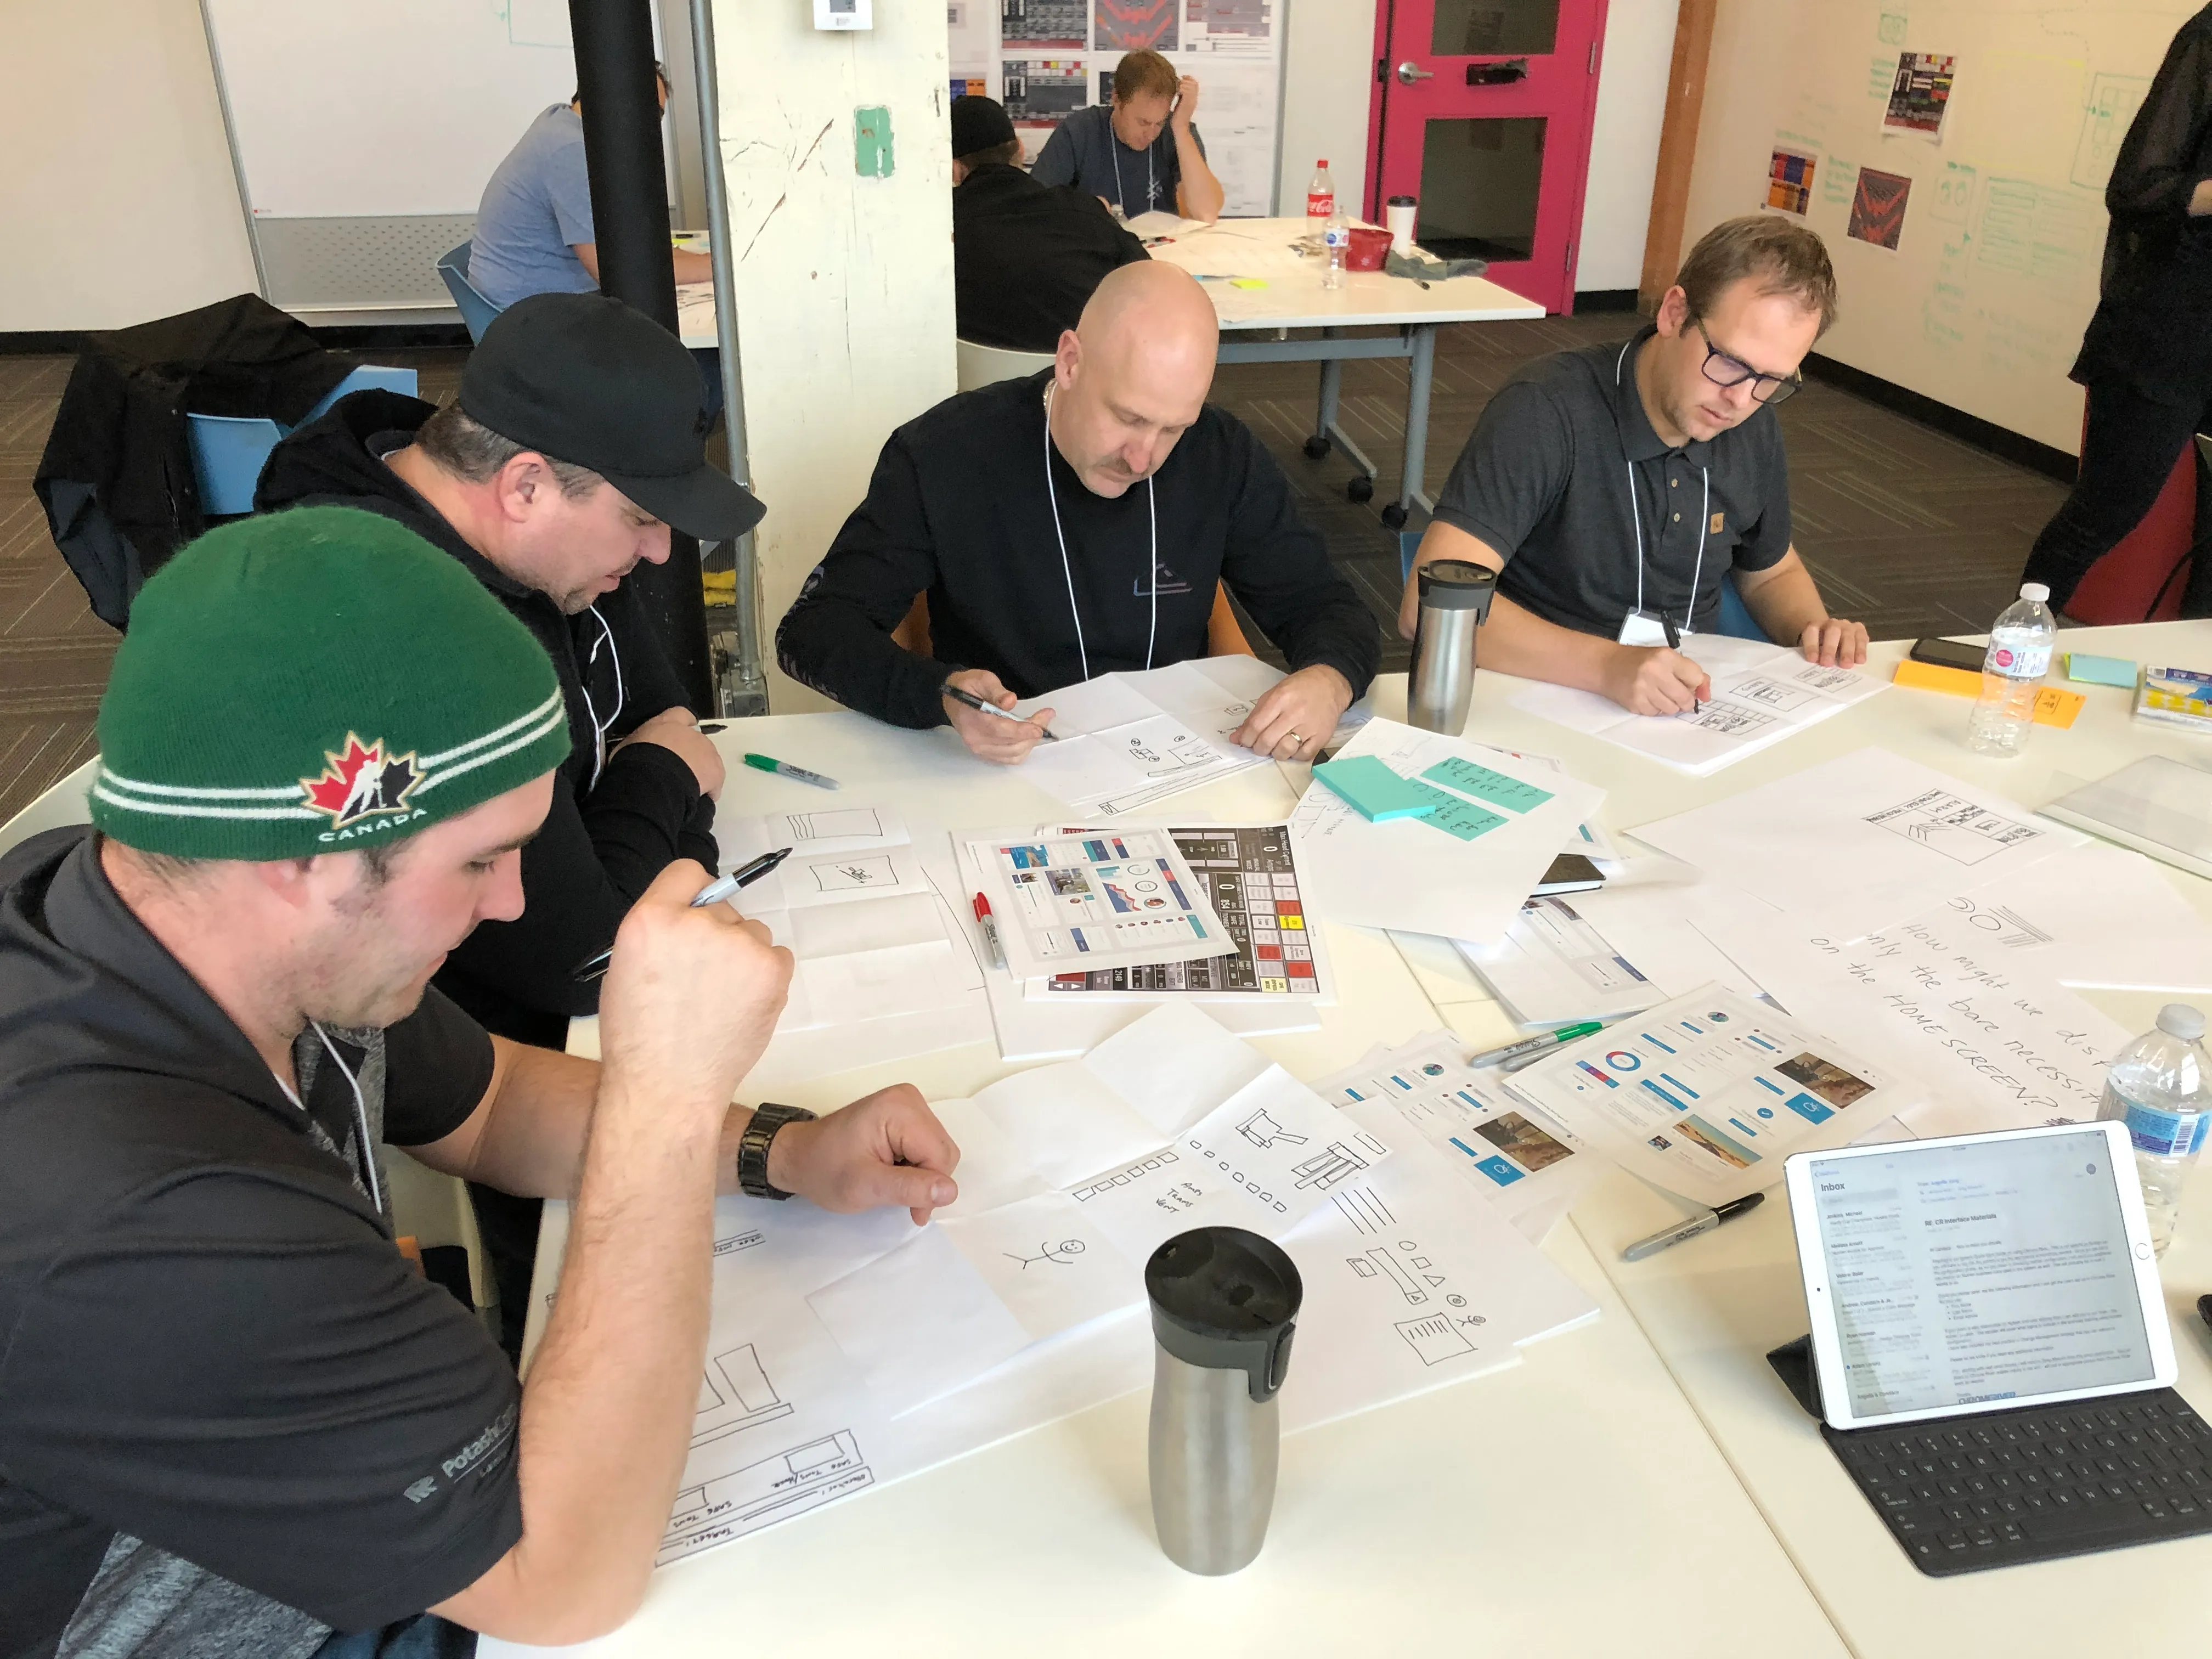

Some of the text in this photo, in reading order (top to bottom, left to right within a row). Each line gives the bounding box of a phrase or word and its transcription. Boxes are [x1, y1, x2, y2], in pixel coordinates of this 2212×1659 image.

[319, 808, 427, 842] CANADA
[1220, 899, 1230, 910] 854
[1901, 924, 1948, 951] How
[1953, 956, 2010, 989] might
[2014, 999, 2043, 1016] we
[1910, 965, 1941, 990] the
[1948, 997, 1999, 1032] bare
[1810, 939, 2058, 1108] on the HOME SCREEN?
[1821, 1183, 1846, 1192] Inbox
[1945, 1216, 1970, 1224] Interface
[1970, 1213, 1997, 1222] Materials
